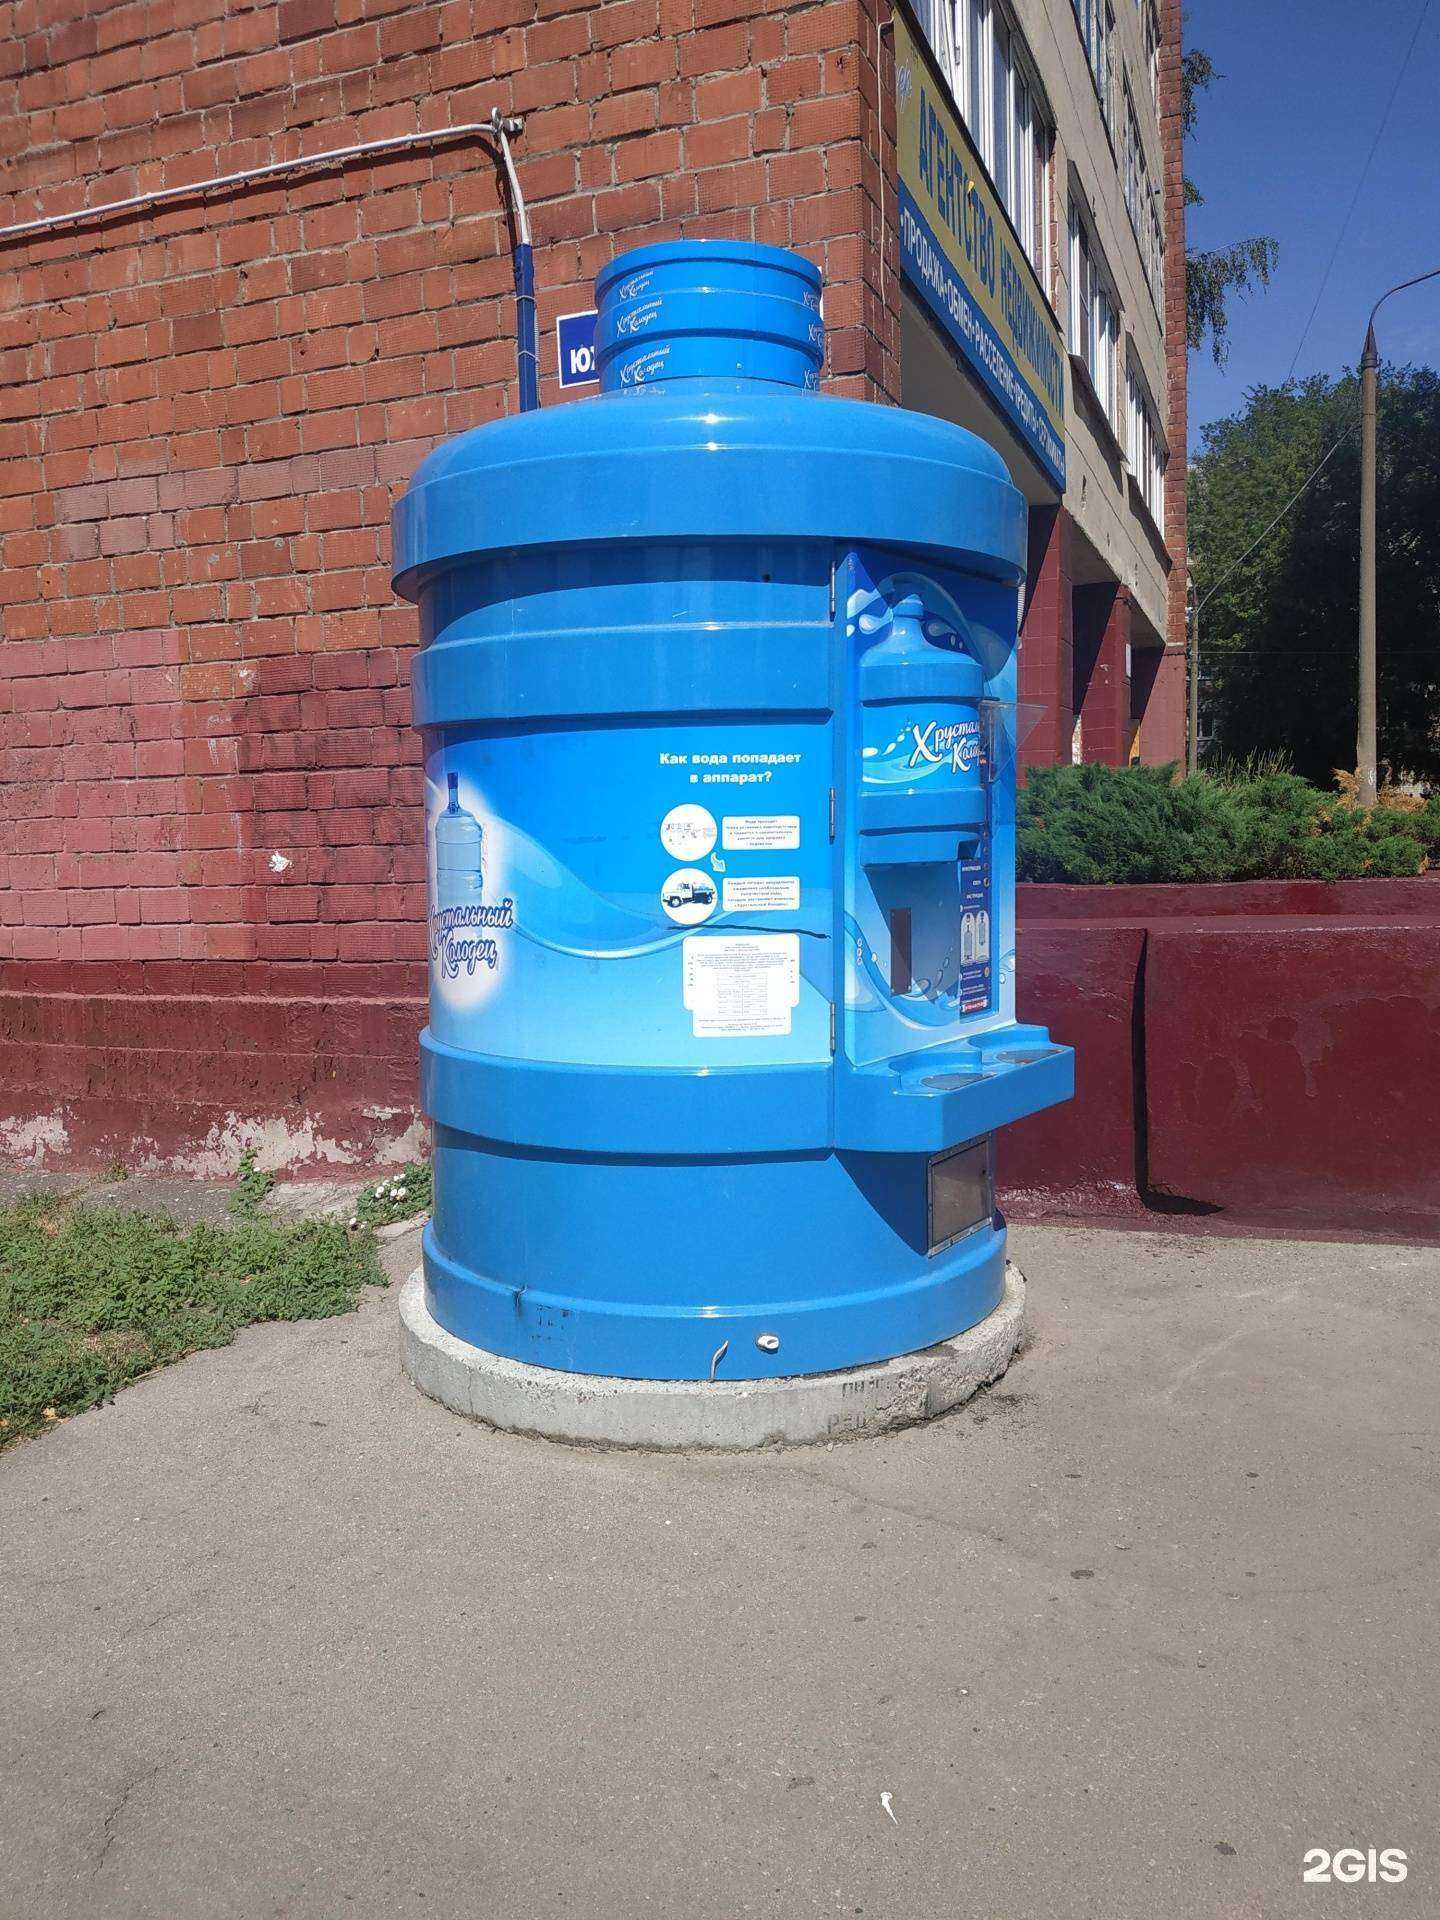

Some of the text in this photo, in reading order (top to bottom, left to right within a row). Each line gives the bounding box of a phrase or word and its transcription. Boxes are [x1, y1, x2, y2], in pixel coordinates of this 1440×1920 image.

[919, 86, 995, 300] АГЕНТСТВО
[903, 207, 946, 304] ПРОДАЖА
[947, 279, 973, 343] ОБМЕН
[660, 752, 802, 766] Как вода попадает
[689, 771, 773, 785] в аппарат?
[441, 927, 497, 979] Колодец
